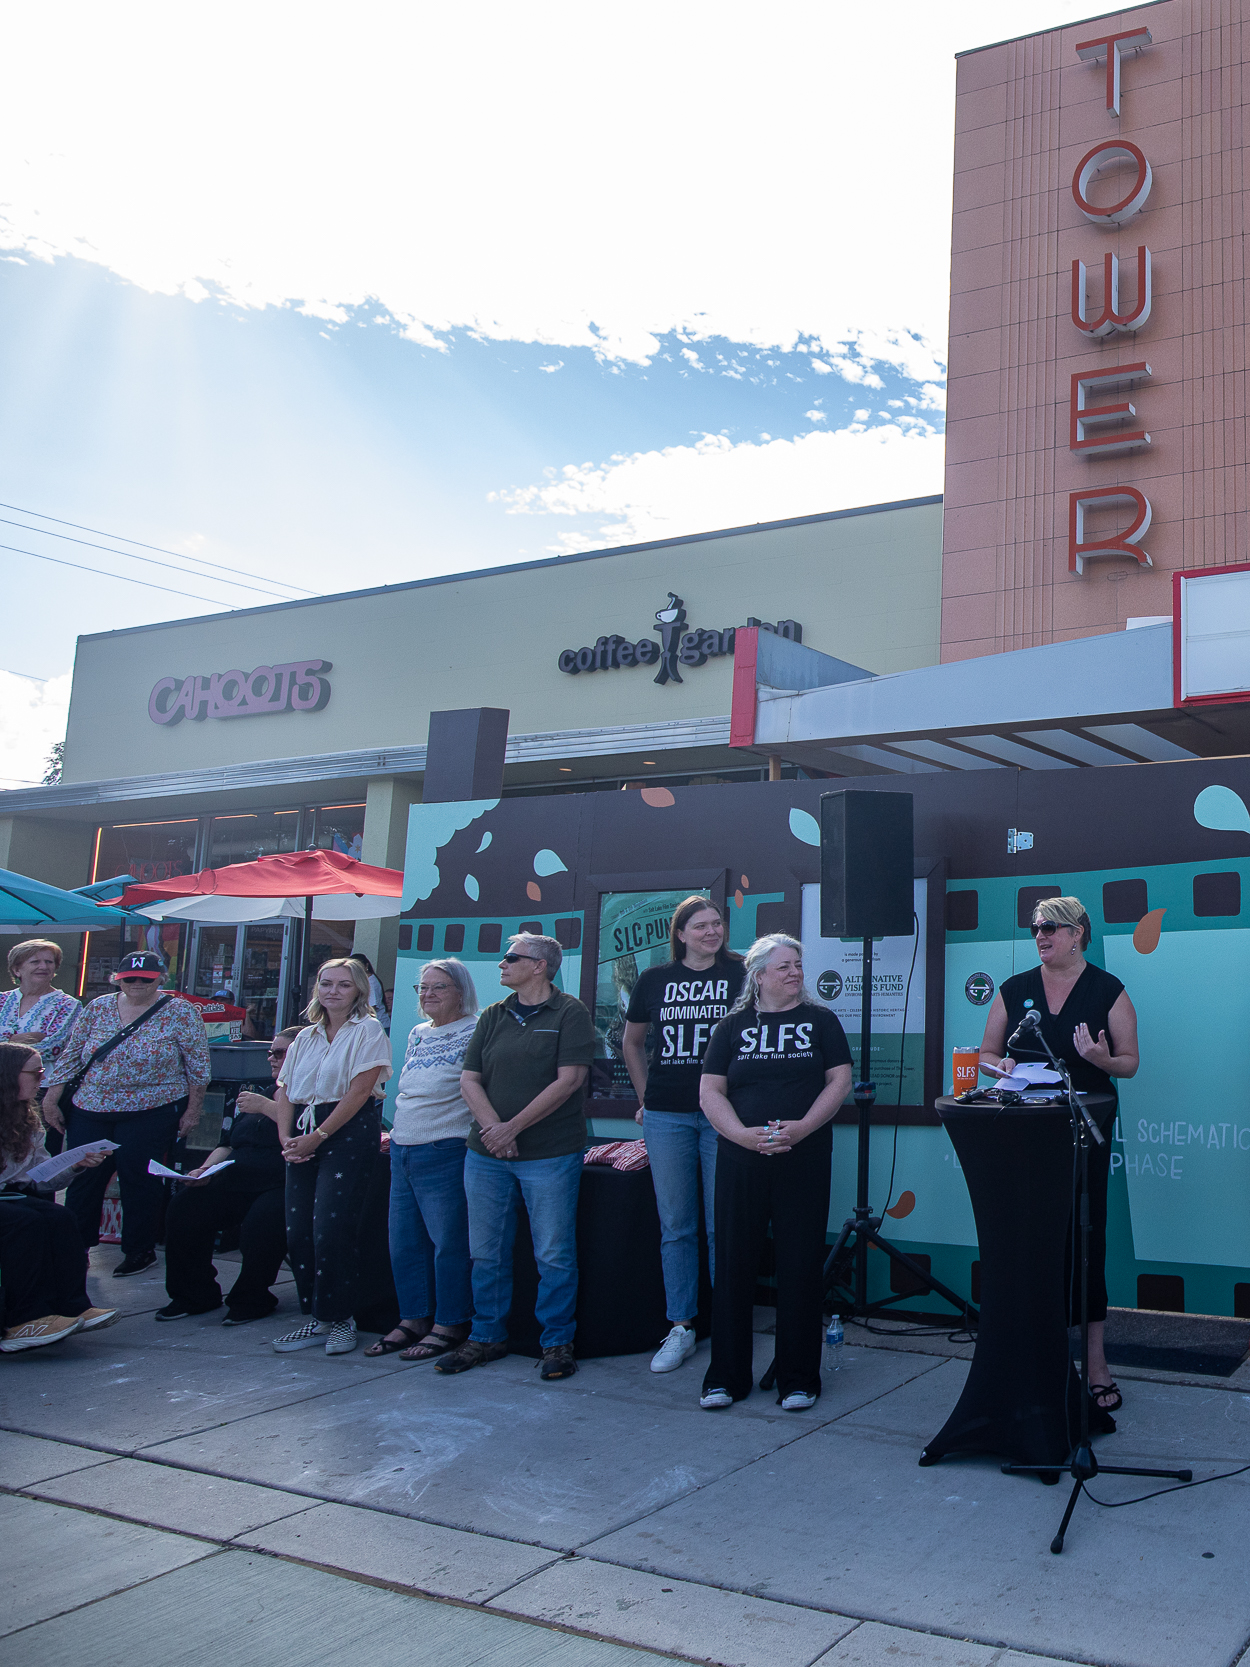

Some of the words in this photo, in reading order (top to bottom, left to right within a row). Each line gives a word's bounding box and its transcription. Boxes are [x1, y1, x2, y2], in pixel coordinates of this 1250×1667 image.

[1069, 27, 1153, 576] TOWER
[558, 634, 661, 675] coffee
[148, 659, 333, 726] CAHOOTS
[613, 921, 643, 953] SLC
[645, 916, 672, 945] PUN
[844, 974, 903, 983] ALTNATIVE
[880, 983, 904, 991] FUND
[663, 980, 729, 1003] OSCAR
[659, 1004, 727, 1022] NOMINATED
[661, 1022, 718, 1058] SLF
[739, 1022, 813, 1053] SLFS
[660, 1058, 671, 1066] salt
[686, 1057, 698, 1065] film
[737, 1053, 750, 1061] salt
[787, 1051, 813, 1059] society
[956, 1066, 976, 1078] SLFS
[1111, 1152, 1184, 1180] PHASE
